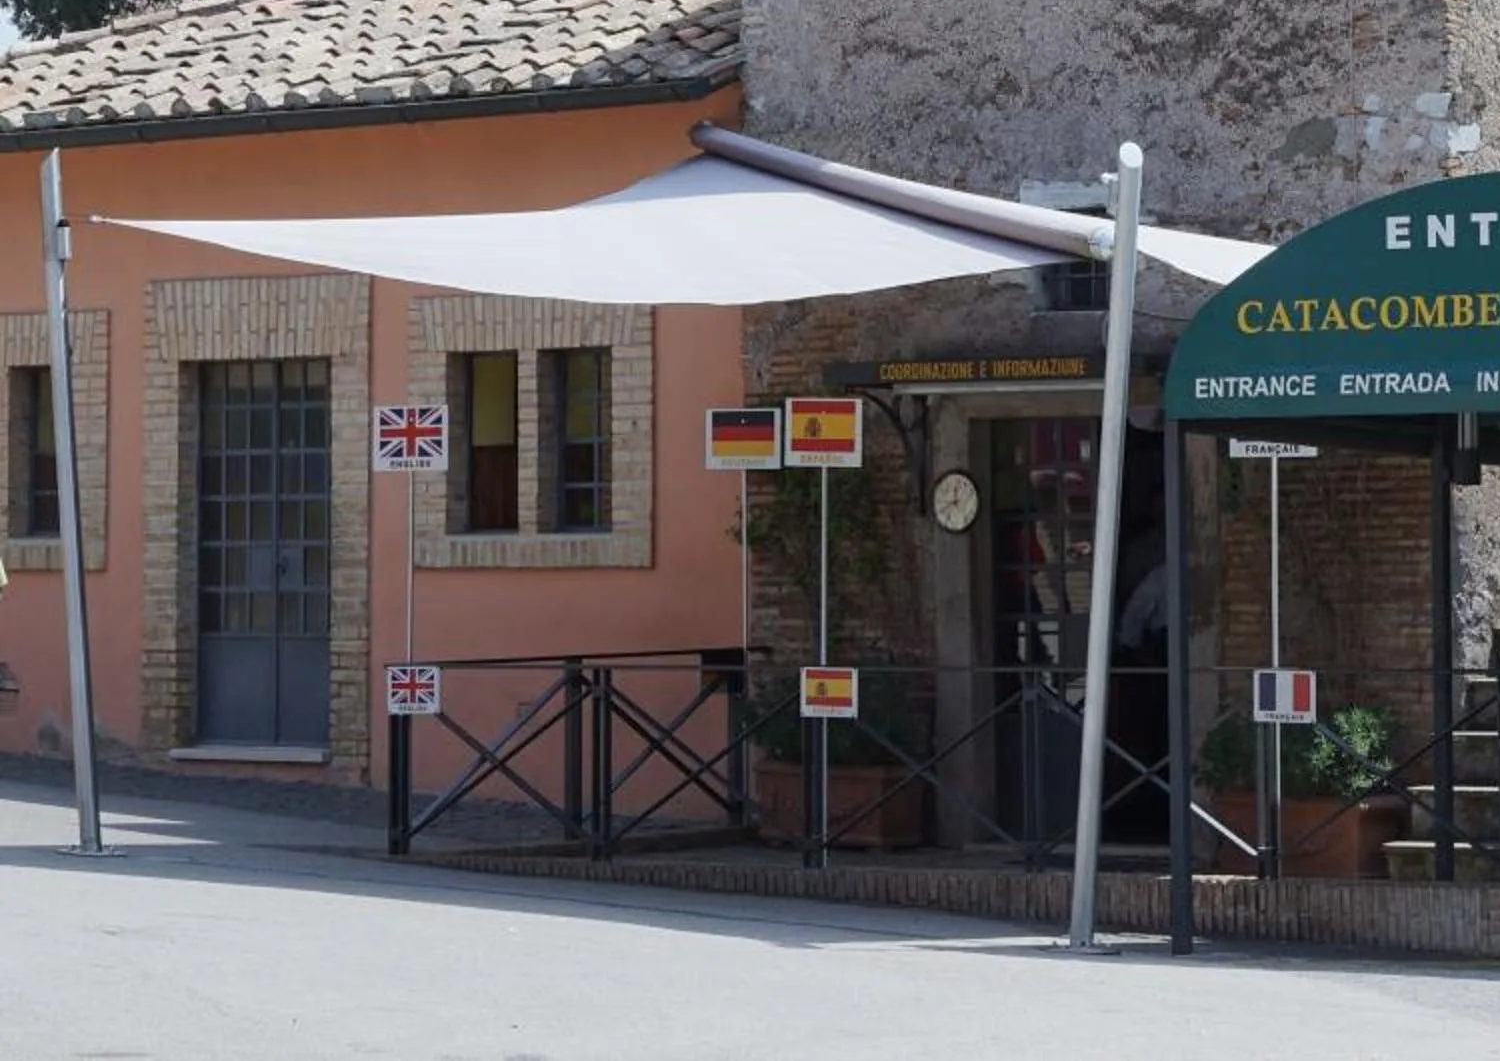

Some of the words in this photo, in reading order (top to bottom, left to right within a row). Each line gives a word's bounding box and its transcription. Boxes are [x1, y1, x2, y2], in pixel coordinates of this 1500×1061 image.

[879, 361, 974, 380] COORDINAZIONE
[979, 360, 988, 378] E
[1195, 374, 1316, 399] ENTRANCE
[1340, 371, 1451, 396] ENTRADA
